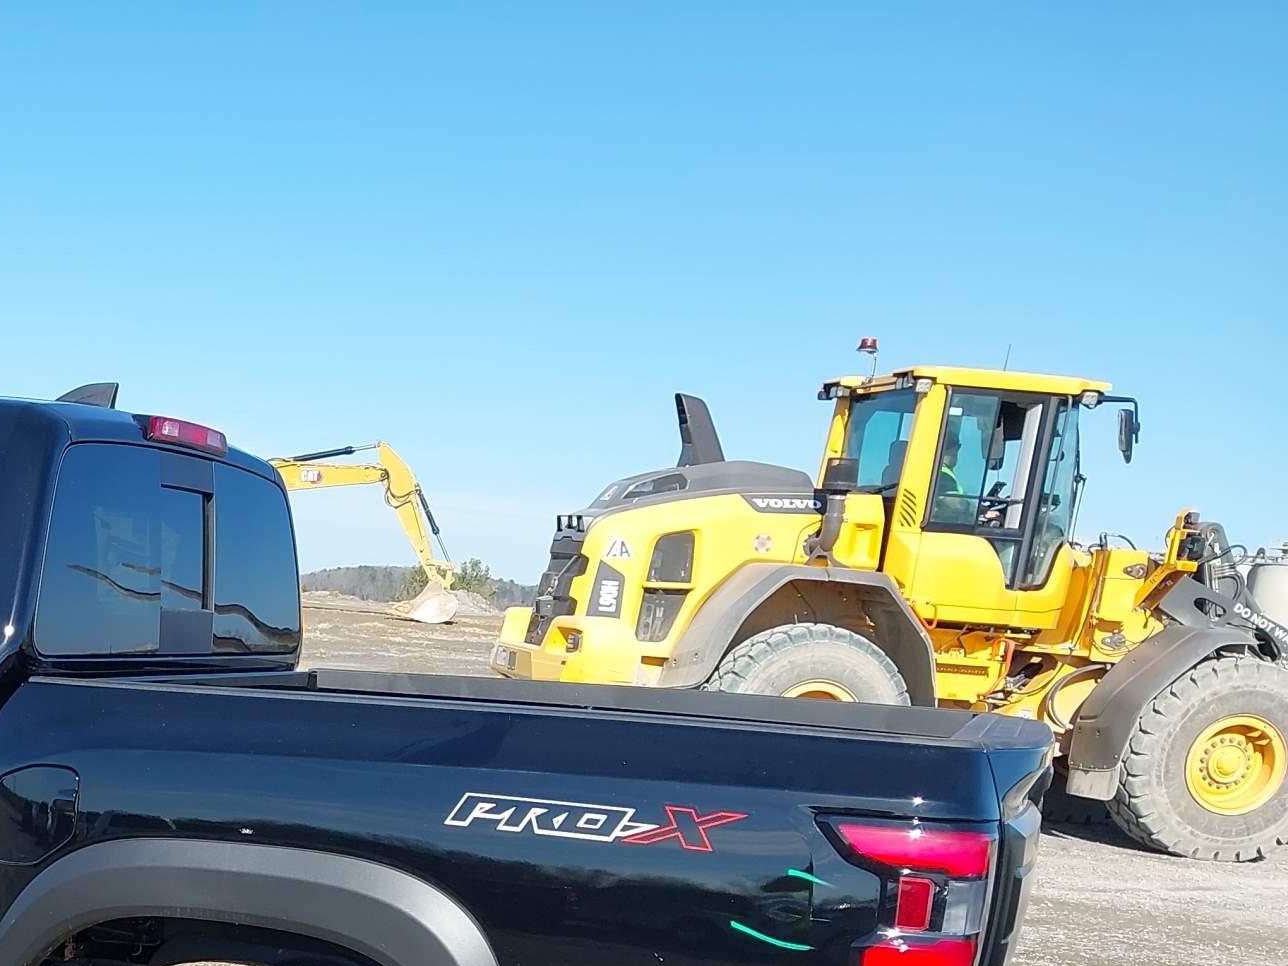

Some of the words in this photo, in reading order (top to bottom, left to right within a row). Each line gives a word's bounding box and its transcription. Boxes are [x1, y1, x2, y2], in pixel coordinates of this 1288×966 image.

[301, 469, 320, 482] CAT
[751, 498, 822, 509] VOLVO
[1234, 603, 1251, 618] DO
[1251, 614, 1275, 632] NOT
